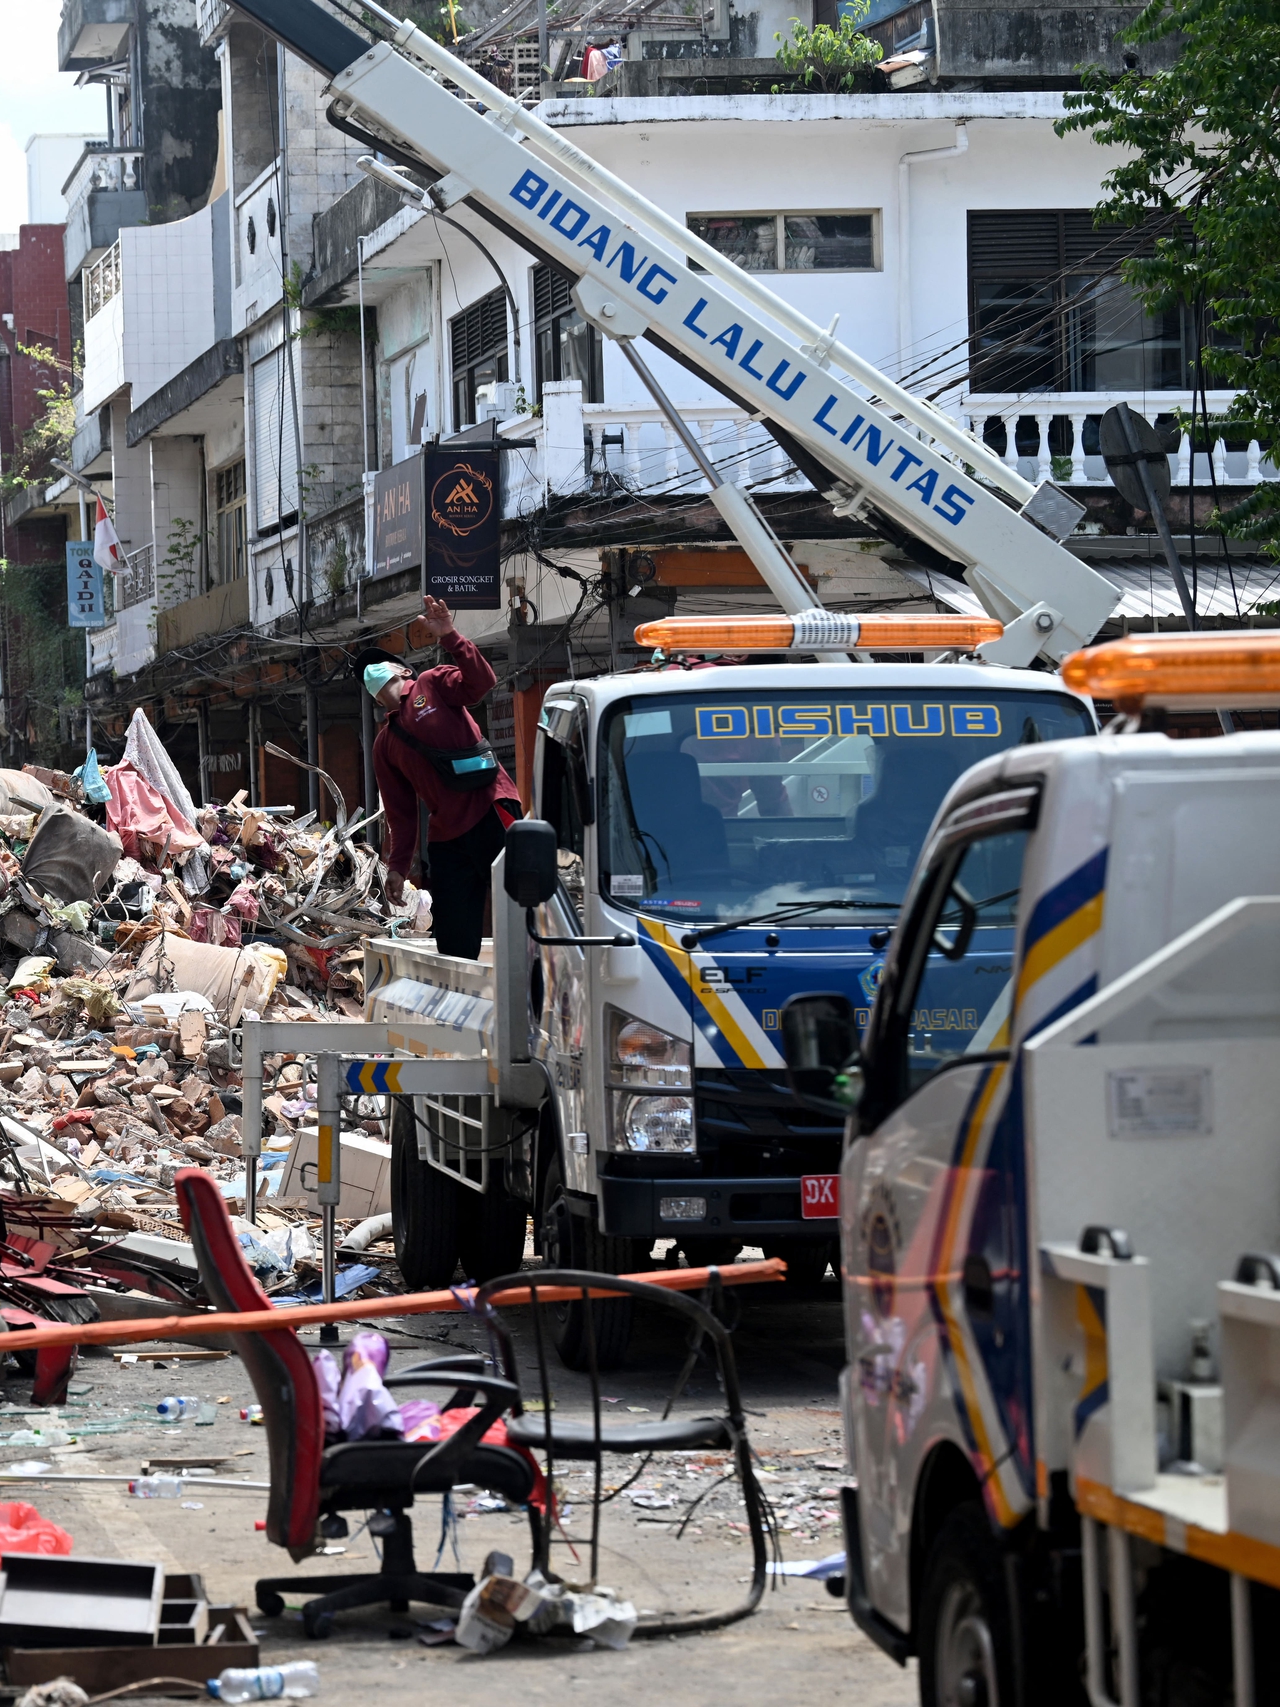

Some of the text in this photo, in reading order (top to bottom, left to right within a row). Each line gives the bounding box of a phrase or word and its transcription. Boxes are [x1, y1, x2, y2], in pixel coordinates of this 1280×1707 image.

[509, 168, 975, 526] BIDANG LALU LINTAS
[383, 481, 411, 522] AN HA
[446, 505, 479, 513] AN HA
[431, 575, 494, 584] GROSIR SONGKET
[695, 704, 1002, 740] DISHUB
[700, 966, 768, 984] ELF
[805, 1178, 835, 1204] DK
